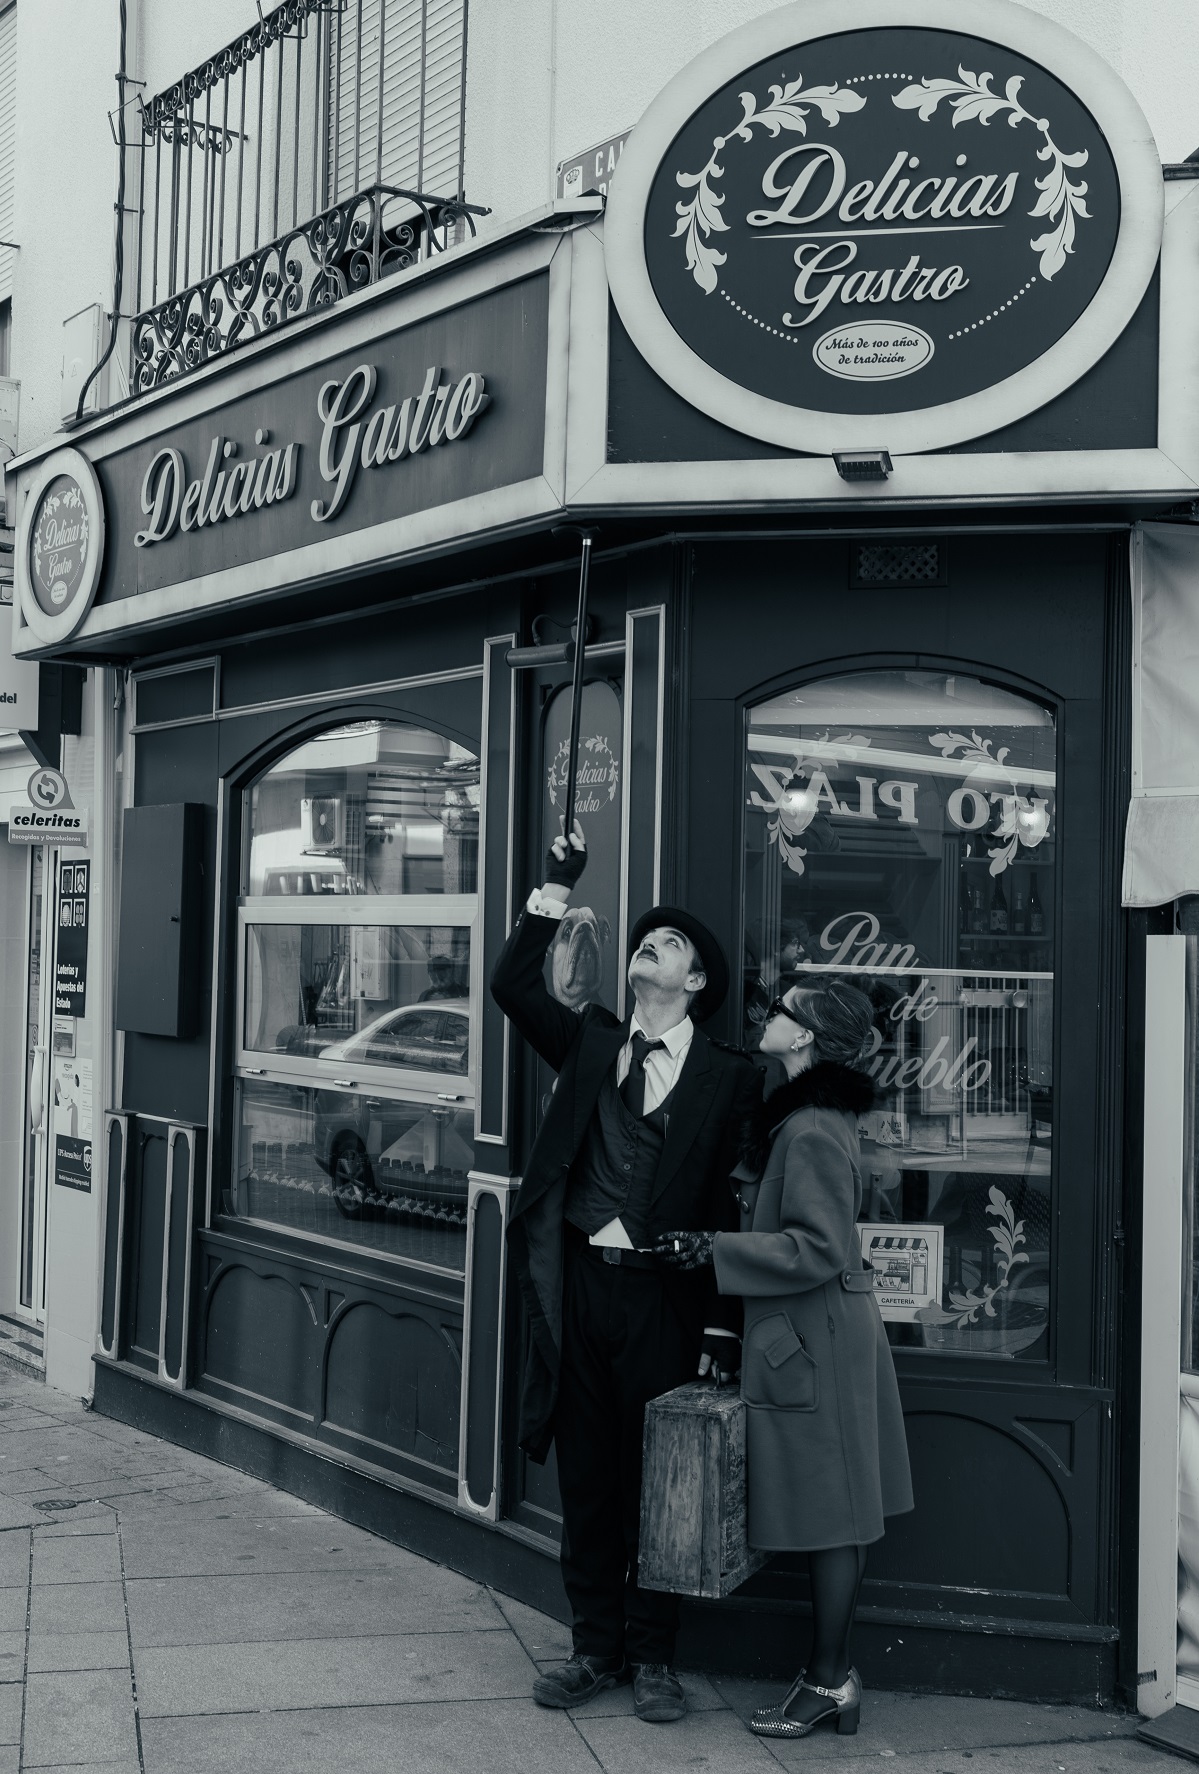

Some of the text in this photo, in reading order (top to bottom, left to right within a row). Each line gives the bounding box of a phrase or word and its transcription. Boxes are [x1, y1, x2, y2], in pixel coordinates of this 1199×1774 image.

[746, 143, 1019, 227] Delicias
[782, 241, 970, 328] Gastro
[825, 336, 919, 350] Más de 100 años
[838, 352, 906, 365] de tradición
[133, 363, 489, 548] Delicias Gastro
[43, 518, 80, 550] Delicias
[47, 553, 72, 586] Gastro
[575, 790, 600, 813] astro
[14, 813, 81, 828] celeritas
[11, 833, 40, 842] Recogidas
[45, 834, 81, 842] Devoluciones
[803, 911, 919, 976] Pan
[75, 966, 79, 978] y
[56, 980, 76, 994] Apuestas
[56, 997, 71, 1009] Estado
[889, 979, 939, 1022] de
[881, 1297, 915, 1305] CAFETERÍA
